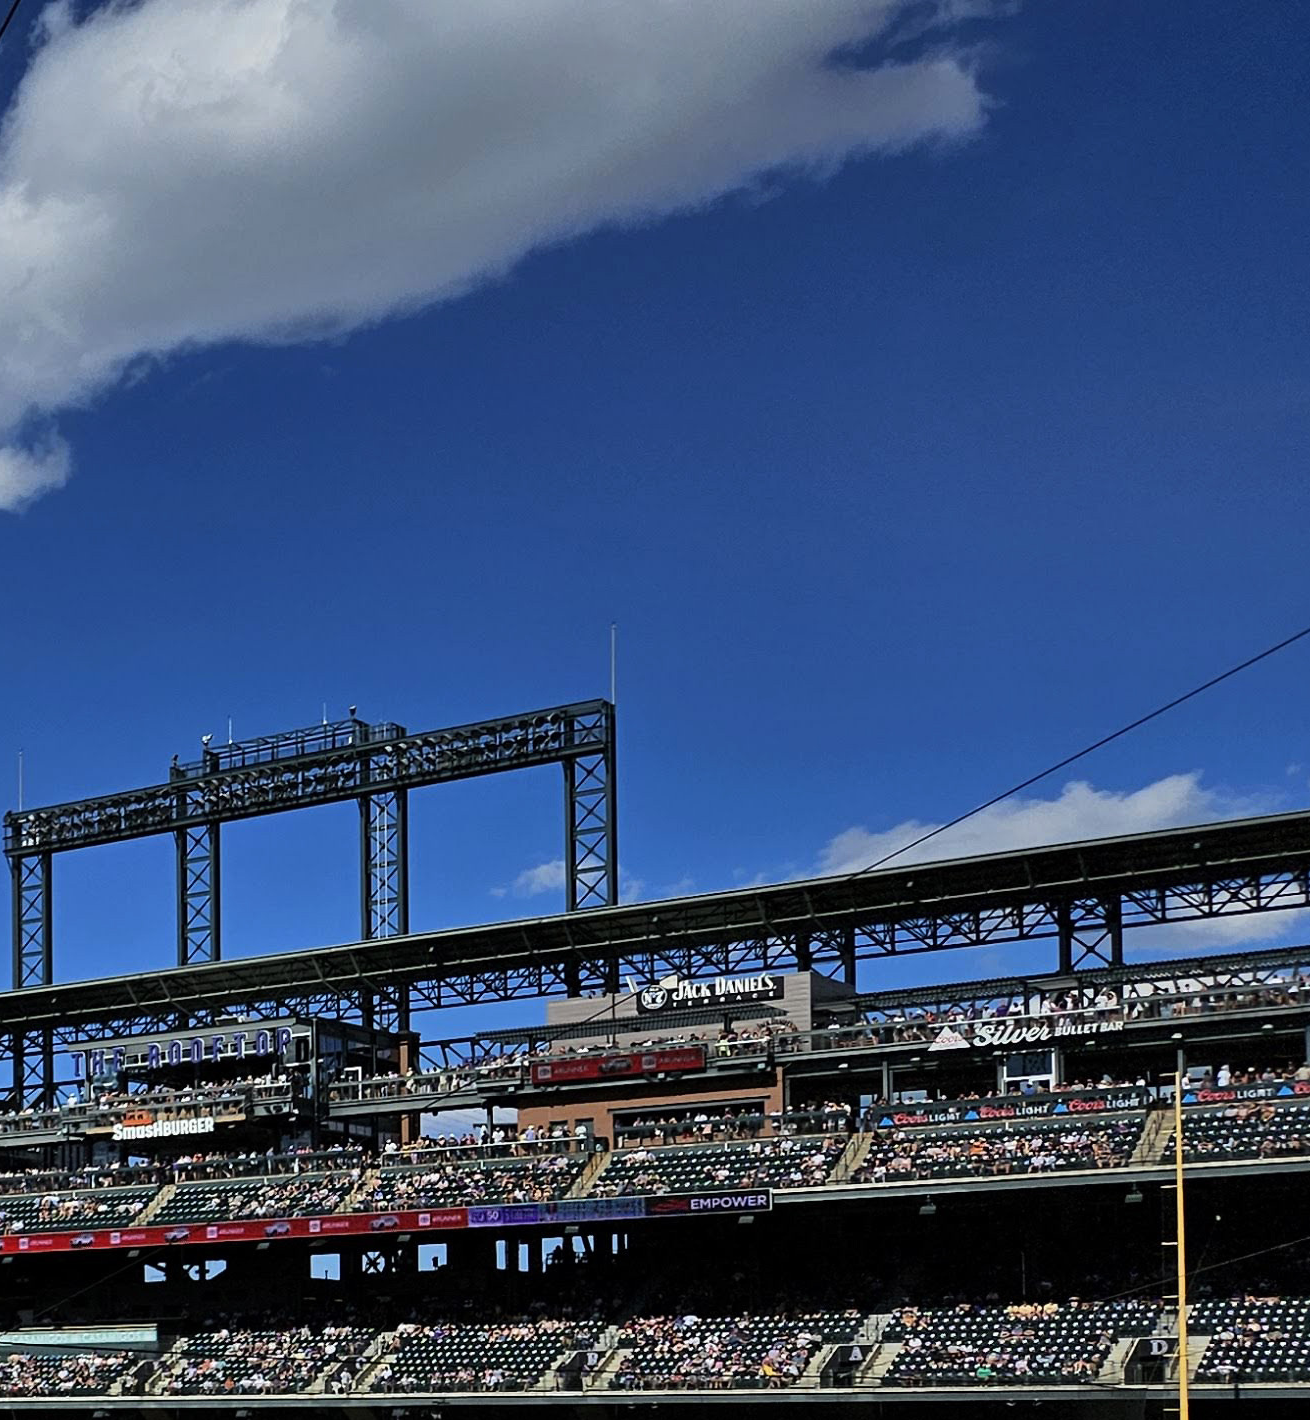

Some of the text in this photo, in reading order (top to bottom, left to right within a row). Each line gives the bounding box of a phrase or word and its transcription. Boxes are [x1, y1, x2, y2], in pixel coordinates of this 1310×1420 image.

[672, 979, 711, 1001] JACK
[972, 1020, 1124, 1048] Silver BULLET BAR
[71, 1027, 294, 1078] THE ROOFTOP
[1197, 1089, 1235, 1102] Coors
[893, 1111, 929, 1124] Coors
[978, 1105, 1014, 1118] Coors
[1067, 1099, 1104, 1112] Coors
[690, 1194, 769, 1211] EMPOWER
[1150, 1339, 1168, 1355] D
